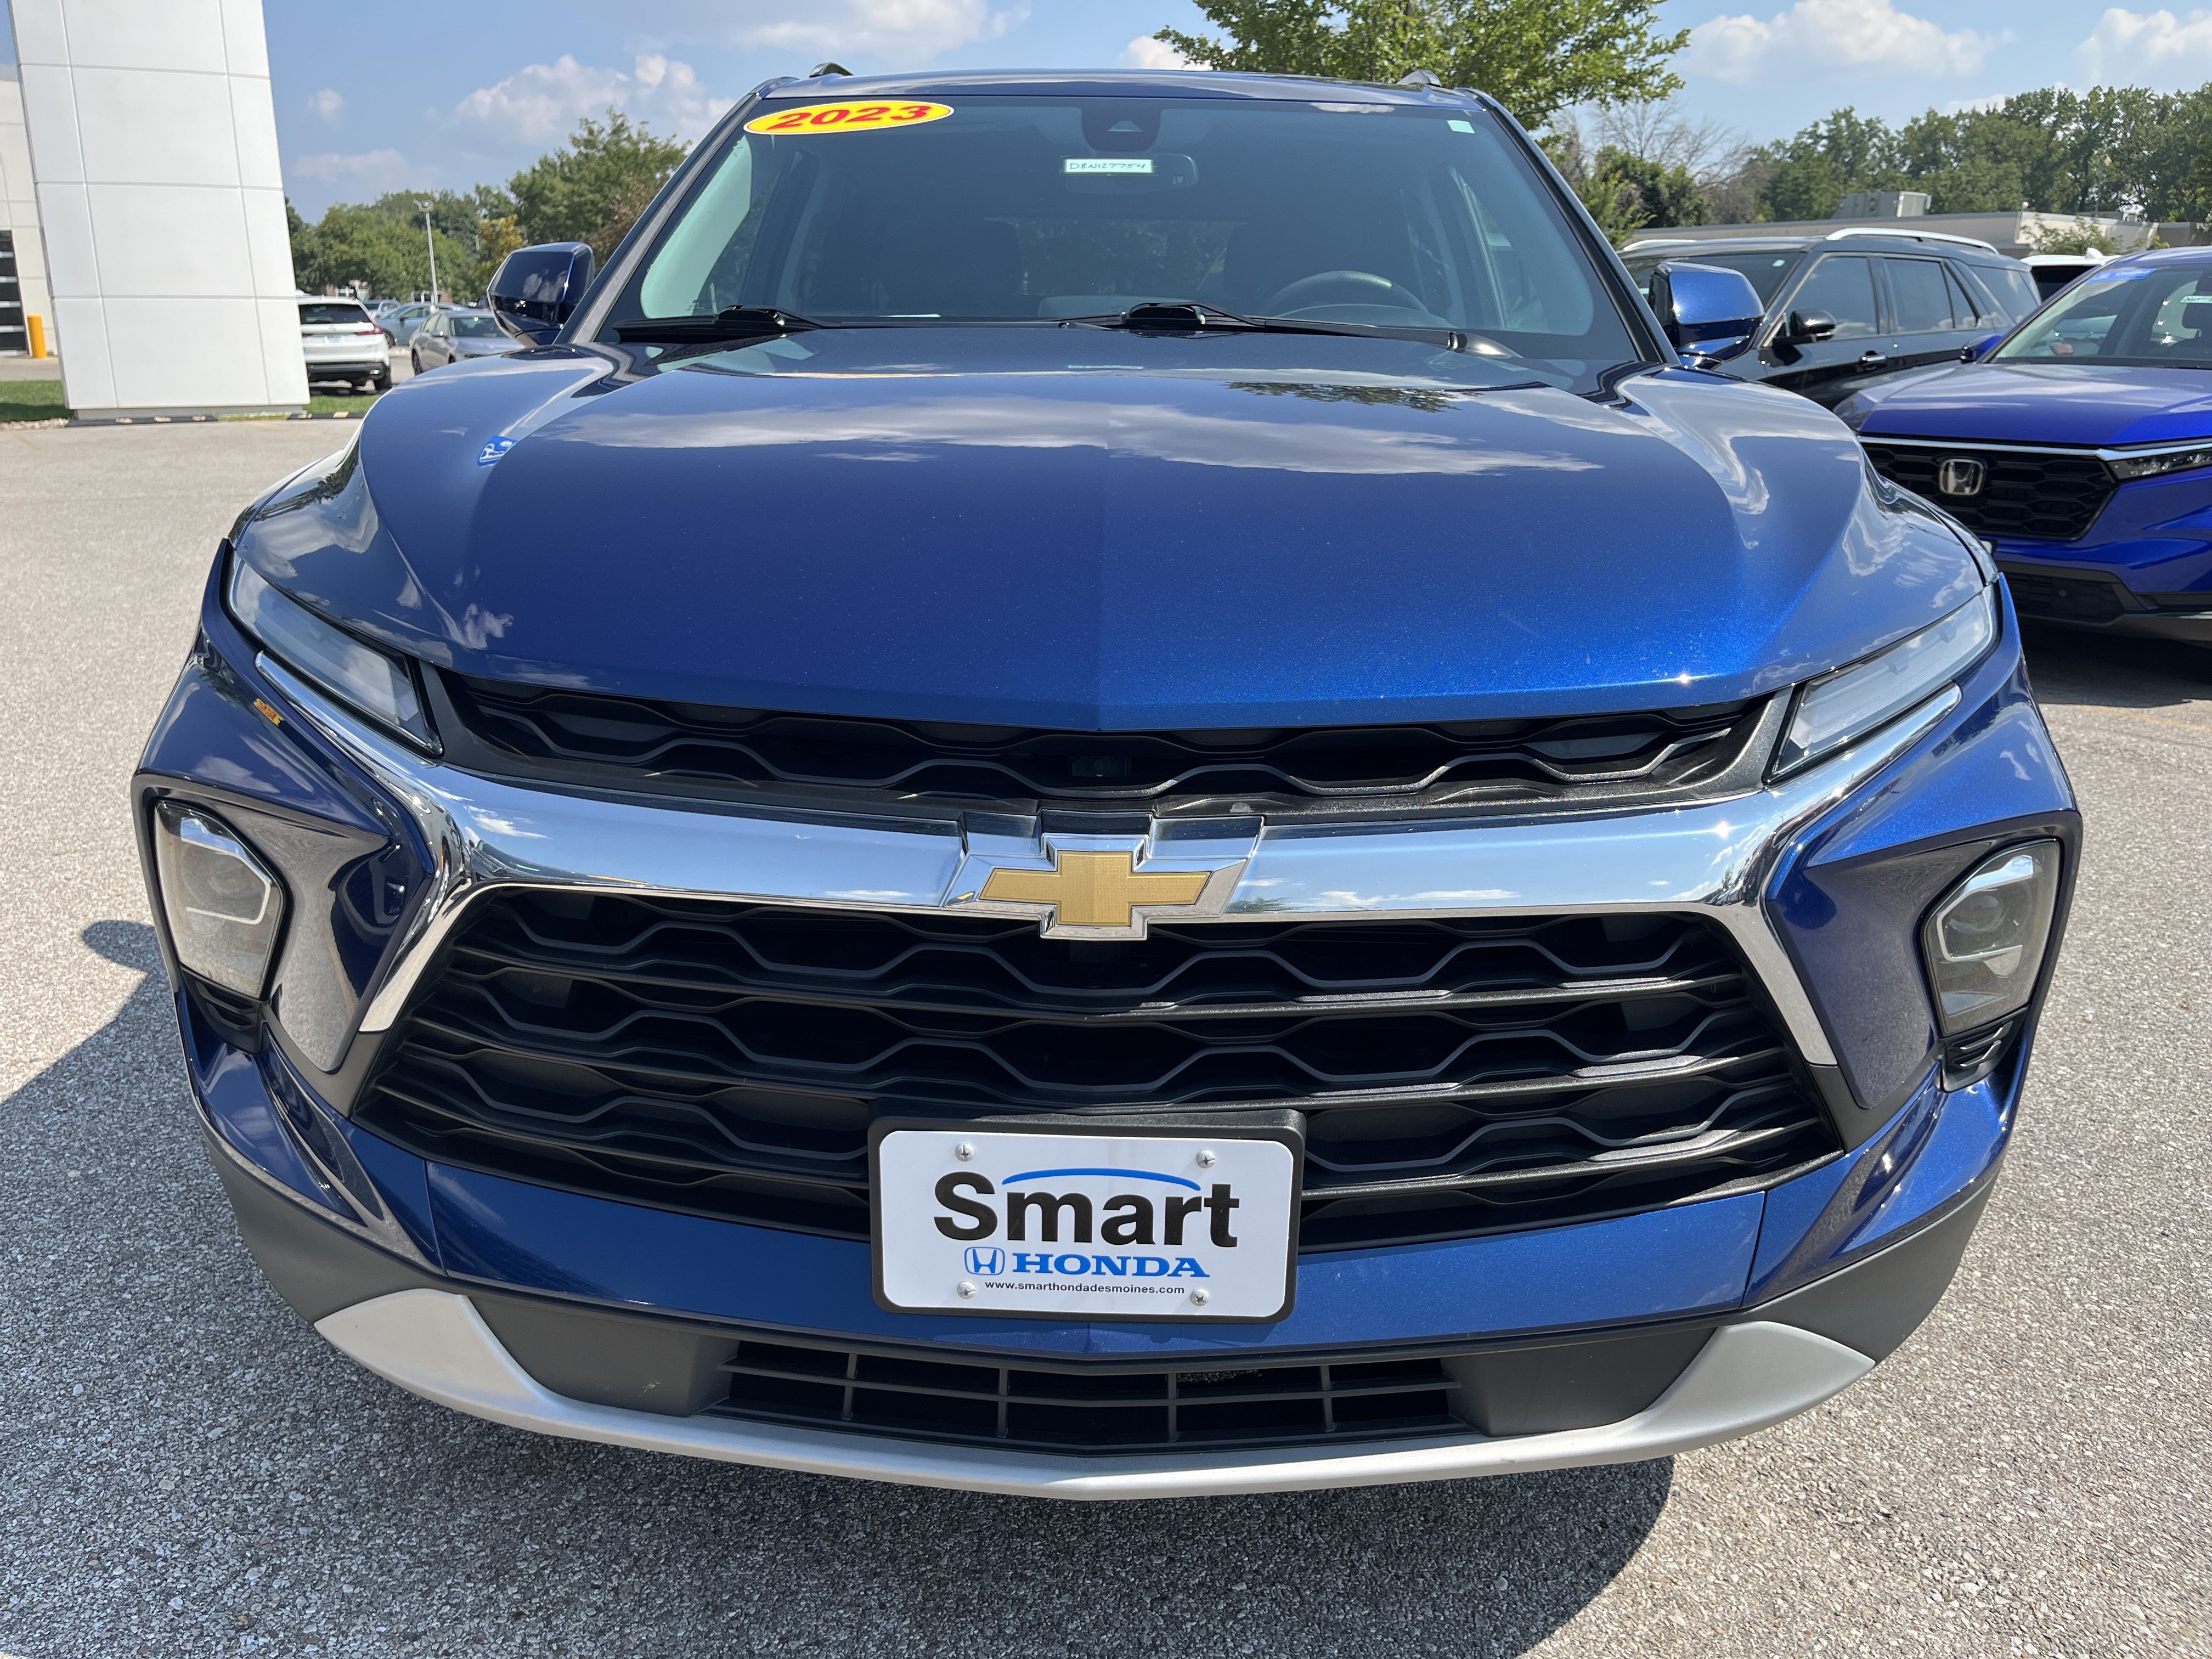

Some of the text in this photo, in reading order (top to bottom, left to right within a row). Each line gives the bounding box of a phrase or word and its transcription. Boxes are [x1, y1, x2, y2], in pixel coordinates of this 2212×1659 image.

[765, 105, 932, 131] 2023
[934, 1171, 1240, 1248] Smart
[1012, 1252, 1210, 1278] HONDA
[985, 1281, 1185, 1294] www.smarthondadesmoines.com
